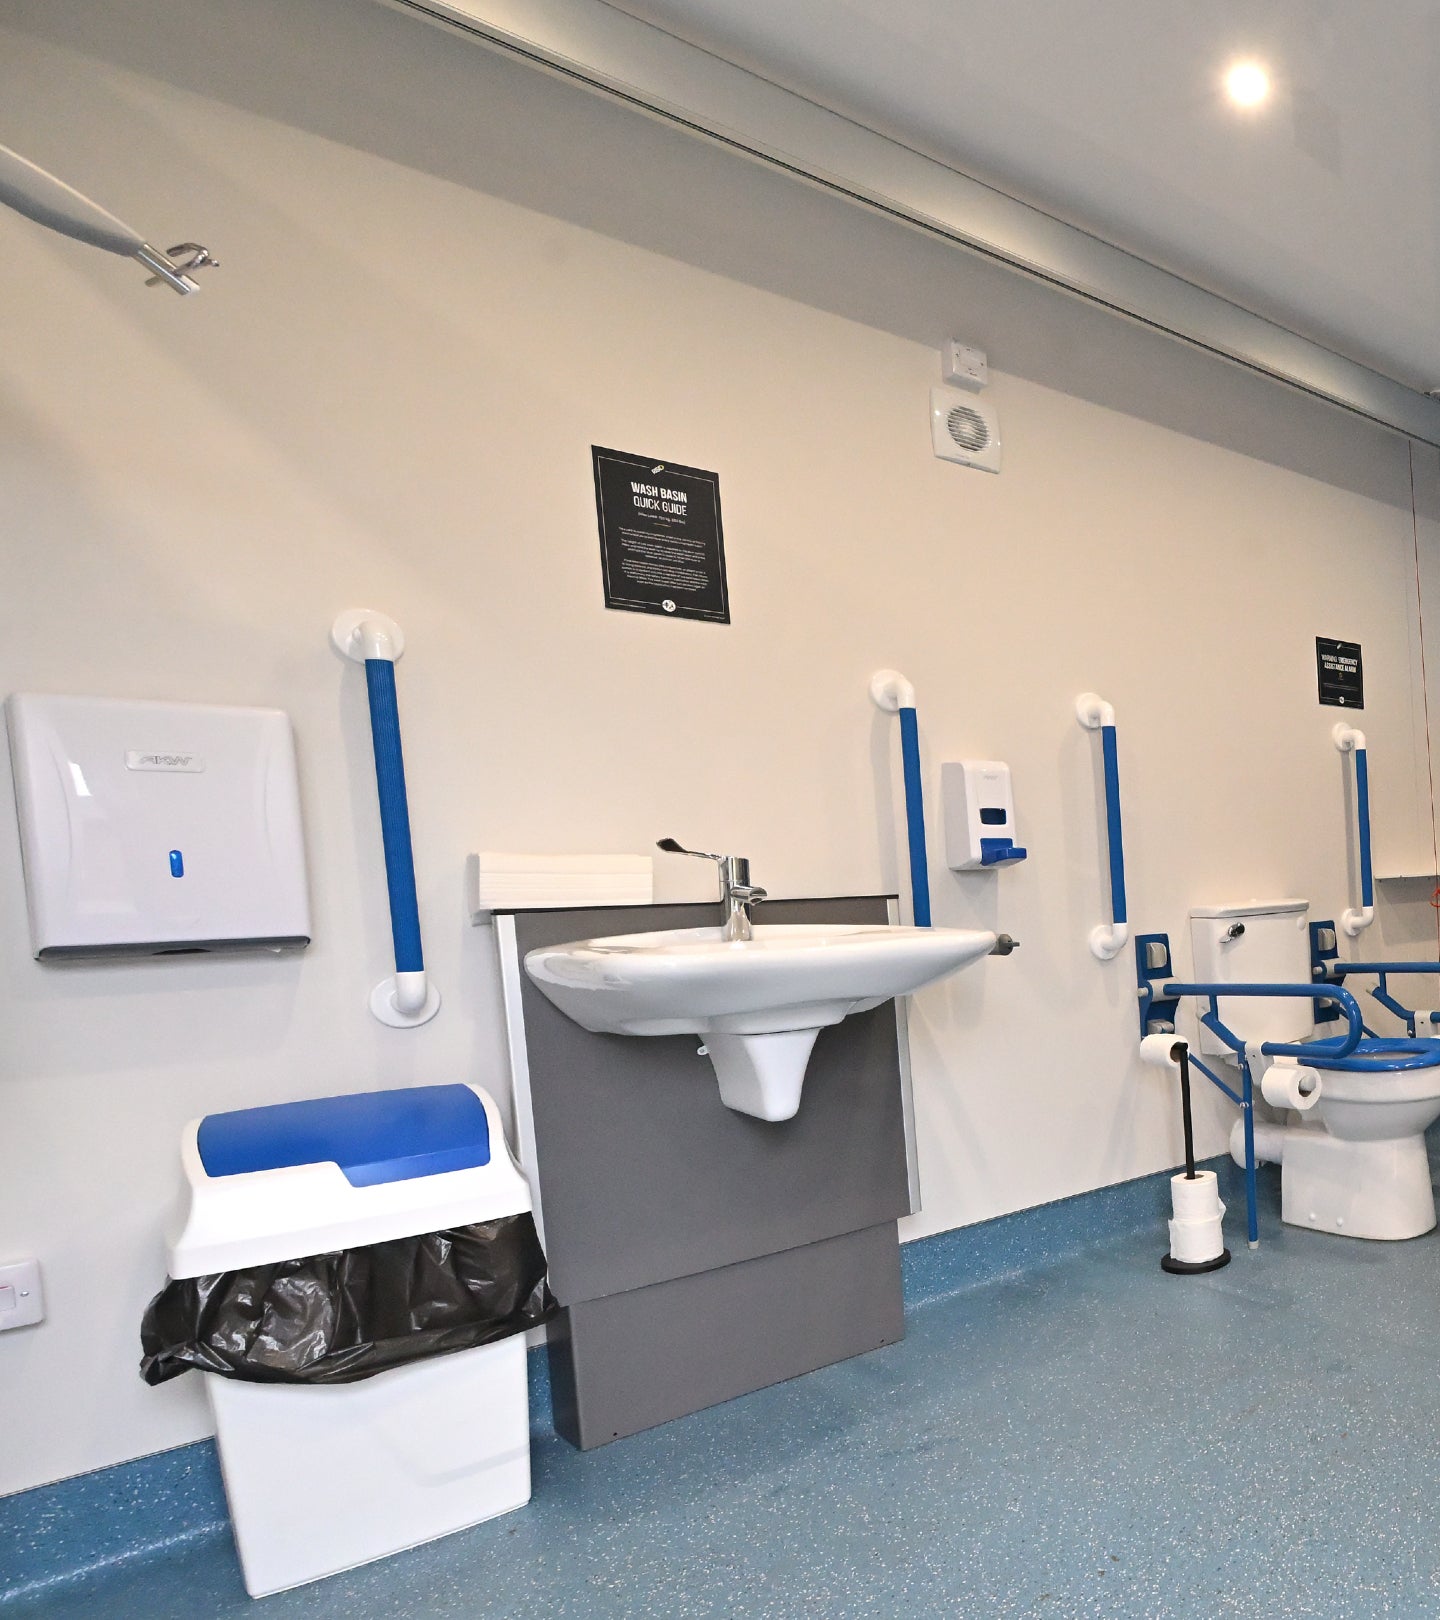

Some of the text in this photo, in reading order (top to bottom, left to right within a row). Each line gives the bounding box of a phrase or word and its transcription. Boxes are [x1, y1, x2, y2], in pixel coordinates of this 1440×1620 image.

[630, 481, 688, 503] WASH BASIN
[633, 496, 688, 516] QUICK GUIDE
